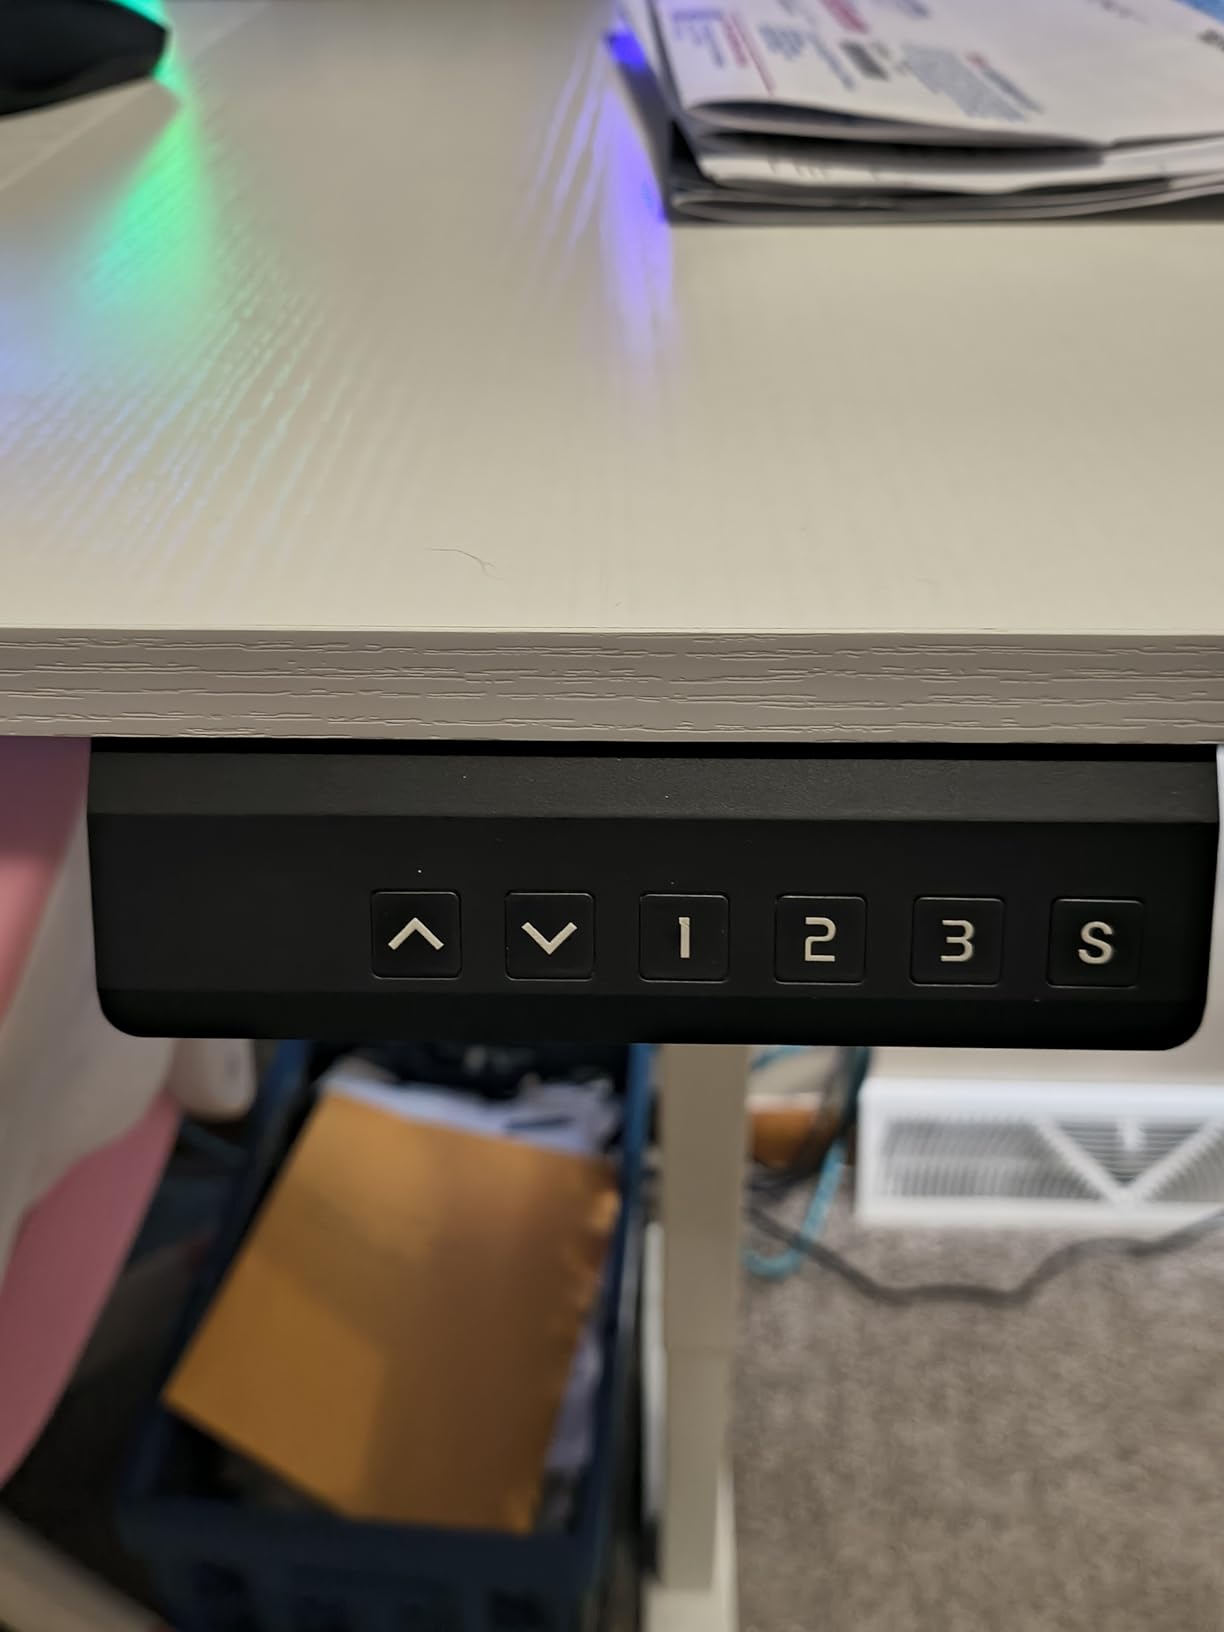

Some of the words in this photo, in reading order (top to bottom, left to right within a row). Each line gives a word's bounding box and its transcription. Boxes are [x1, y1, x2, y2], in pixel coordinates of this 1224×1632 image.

[678, 916, 690, 959] 1
[804, 916, 836, 962] 2
[940, 919, 974, 962] 3
[1078, 921, 1114, 964] S
